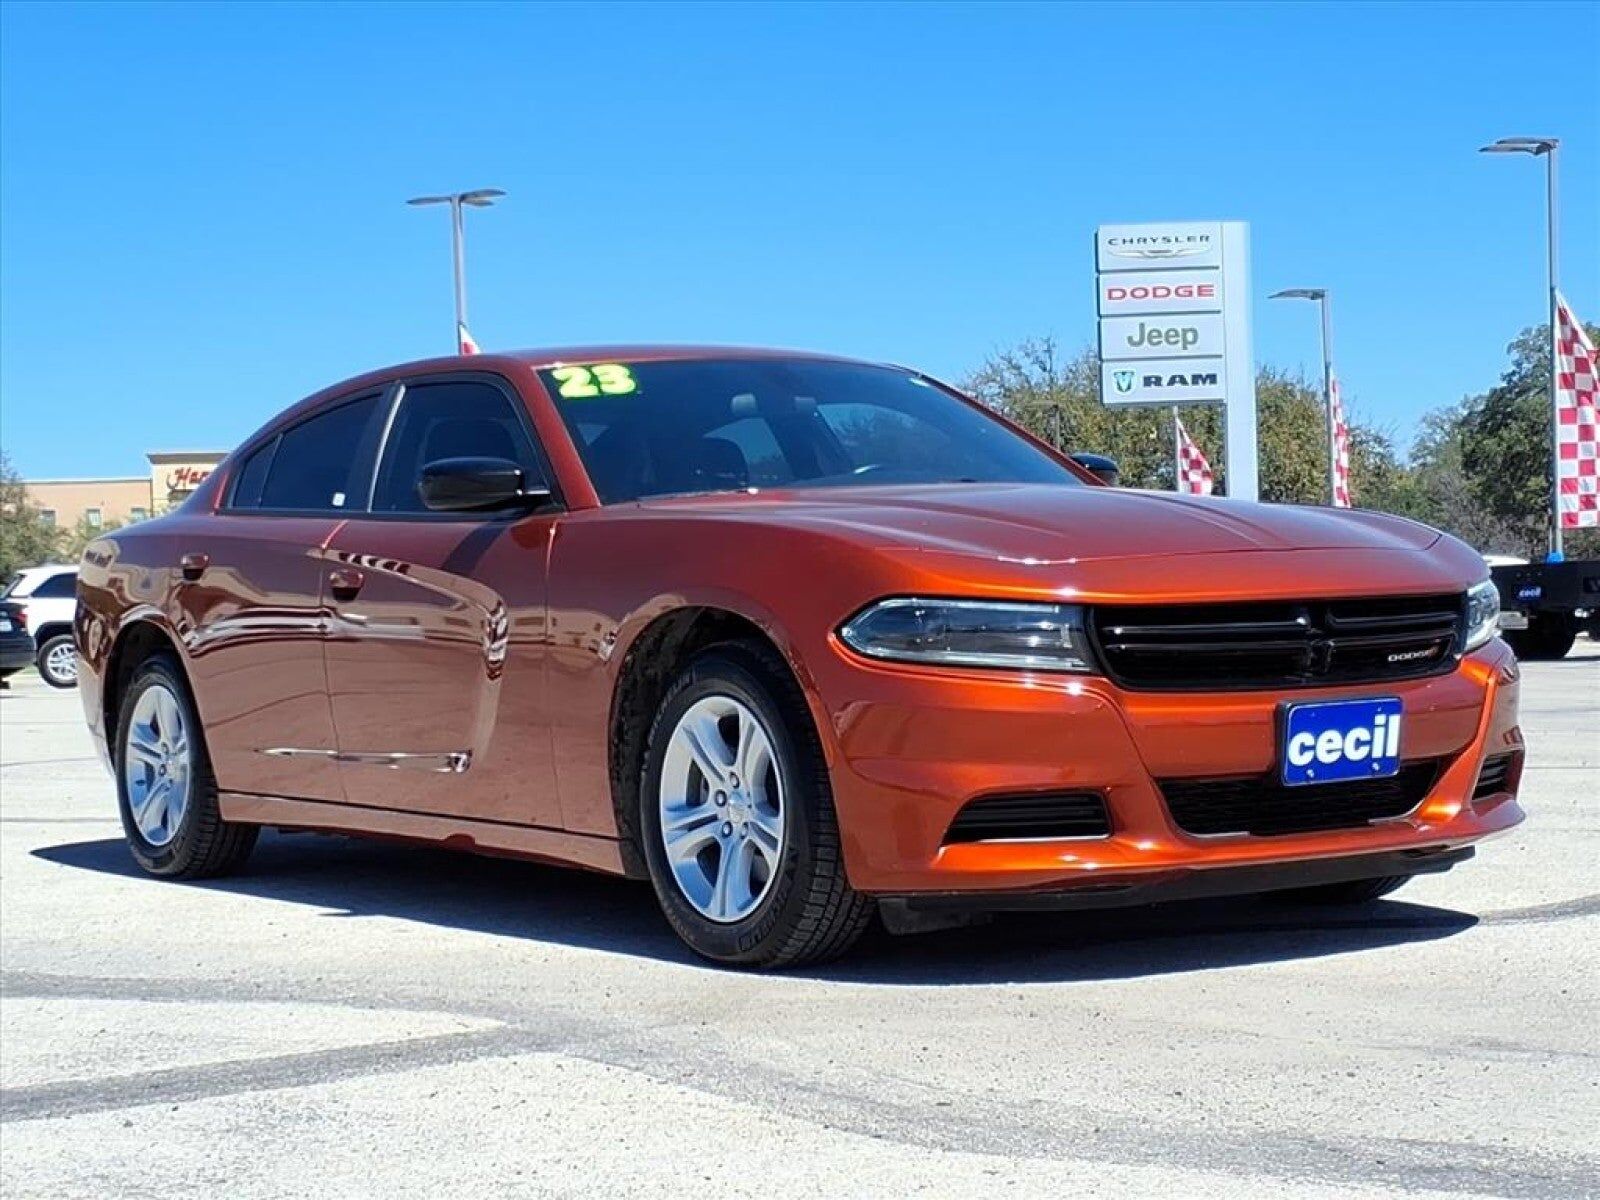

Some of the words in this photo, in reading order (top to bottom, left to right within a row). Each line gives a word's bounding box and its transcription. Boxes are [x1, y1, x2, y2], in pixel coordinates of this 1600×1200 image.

[1107, 235, 1210, 246] CHRYSLER
[1107, 285, 1214, 301] DODGE
[1127, 322, 1199, 350] Jeep
[552, 364, 636, 398] 23
[1143, 373, 1218, 387] RAM
[1288, 713, 1400, 767] cecil
